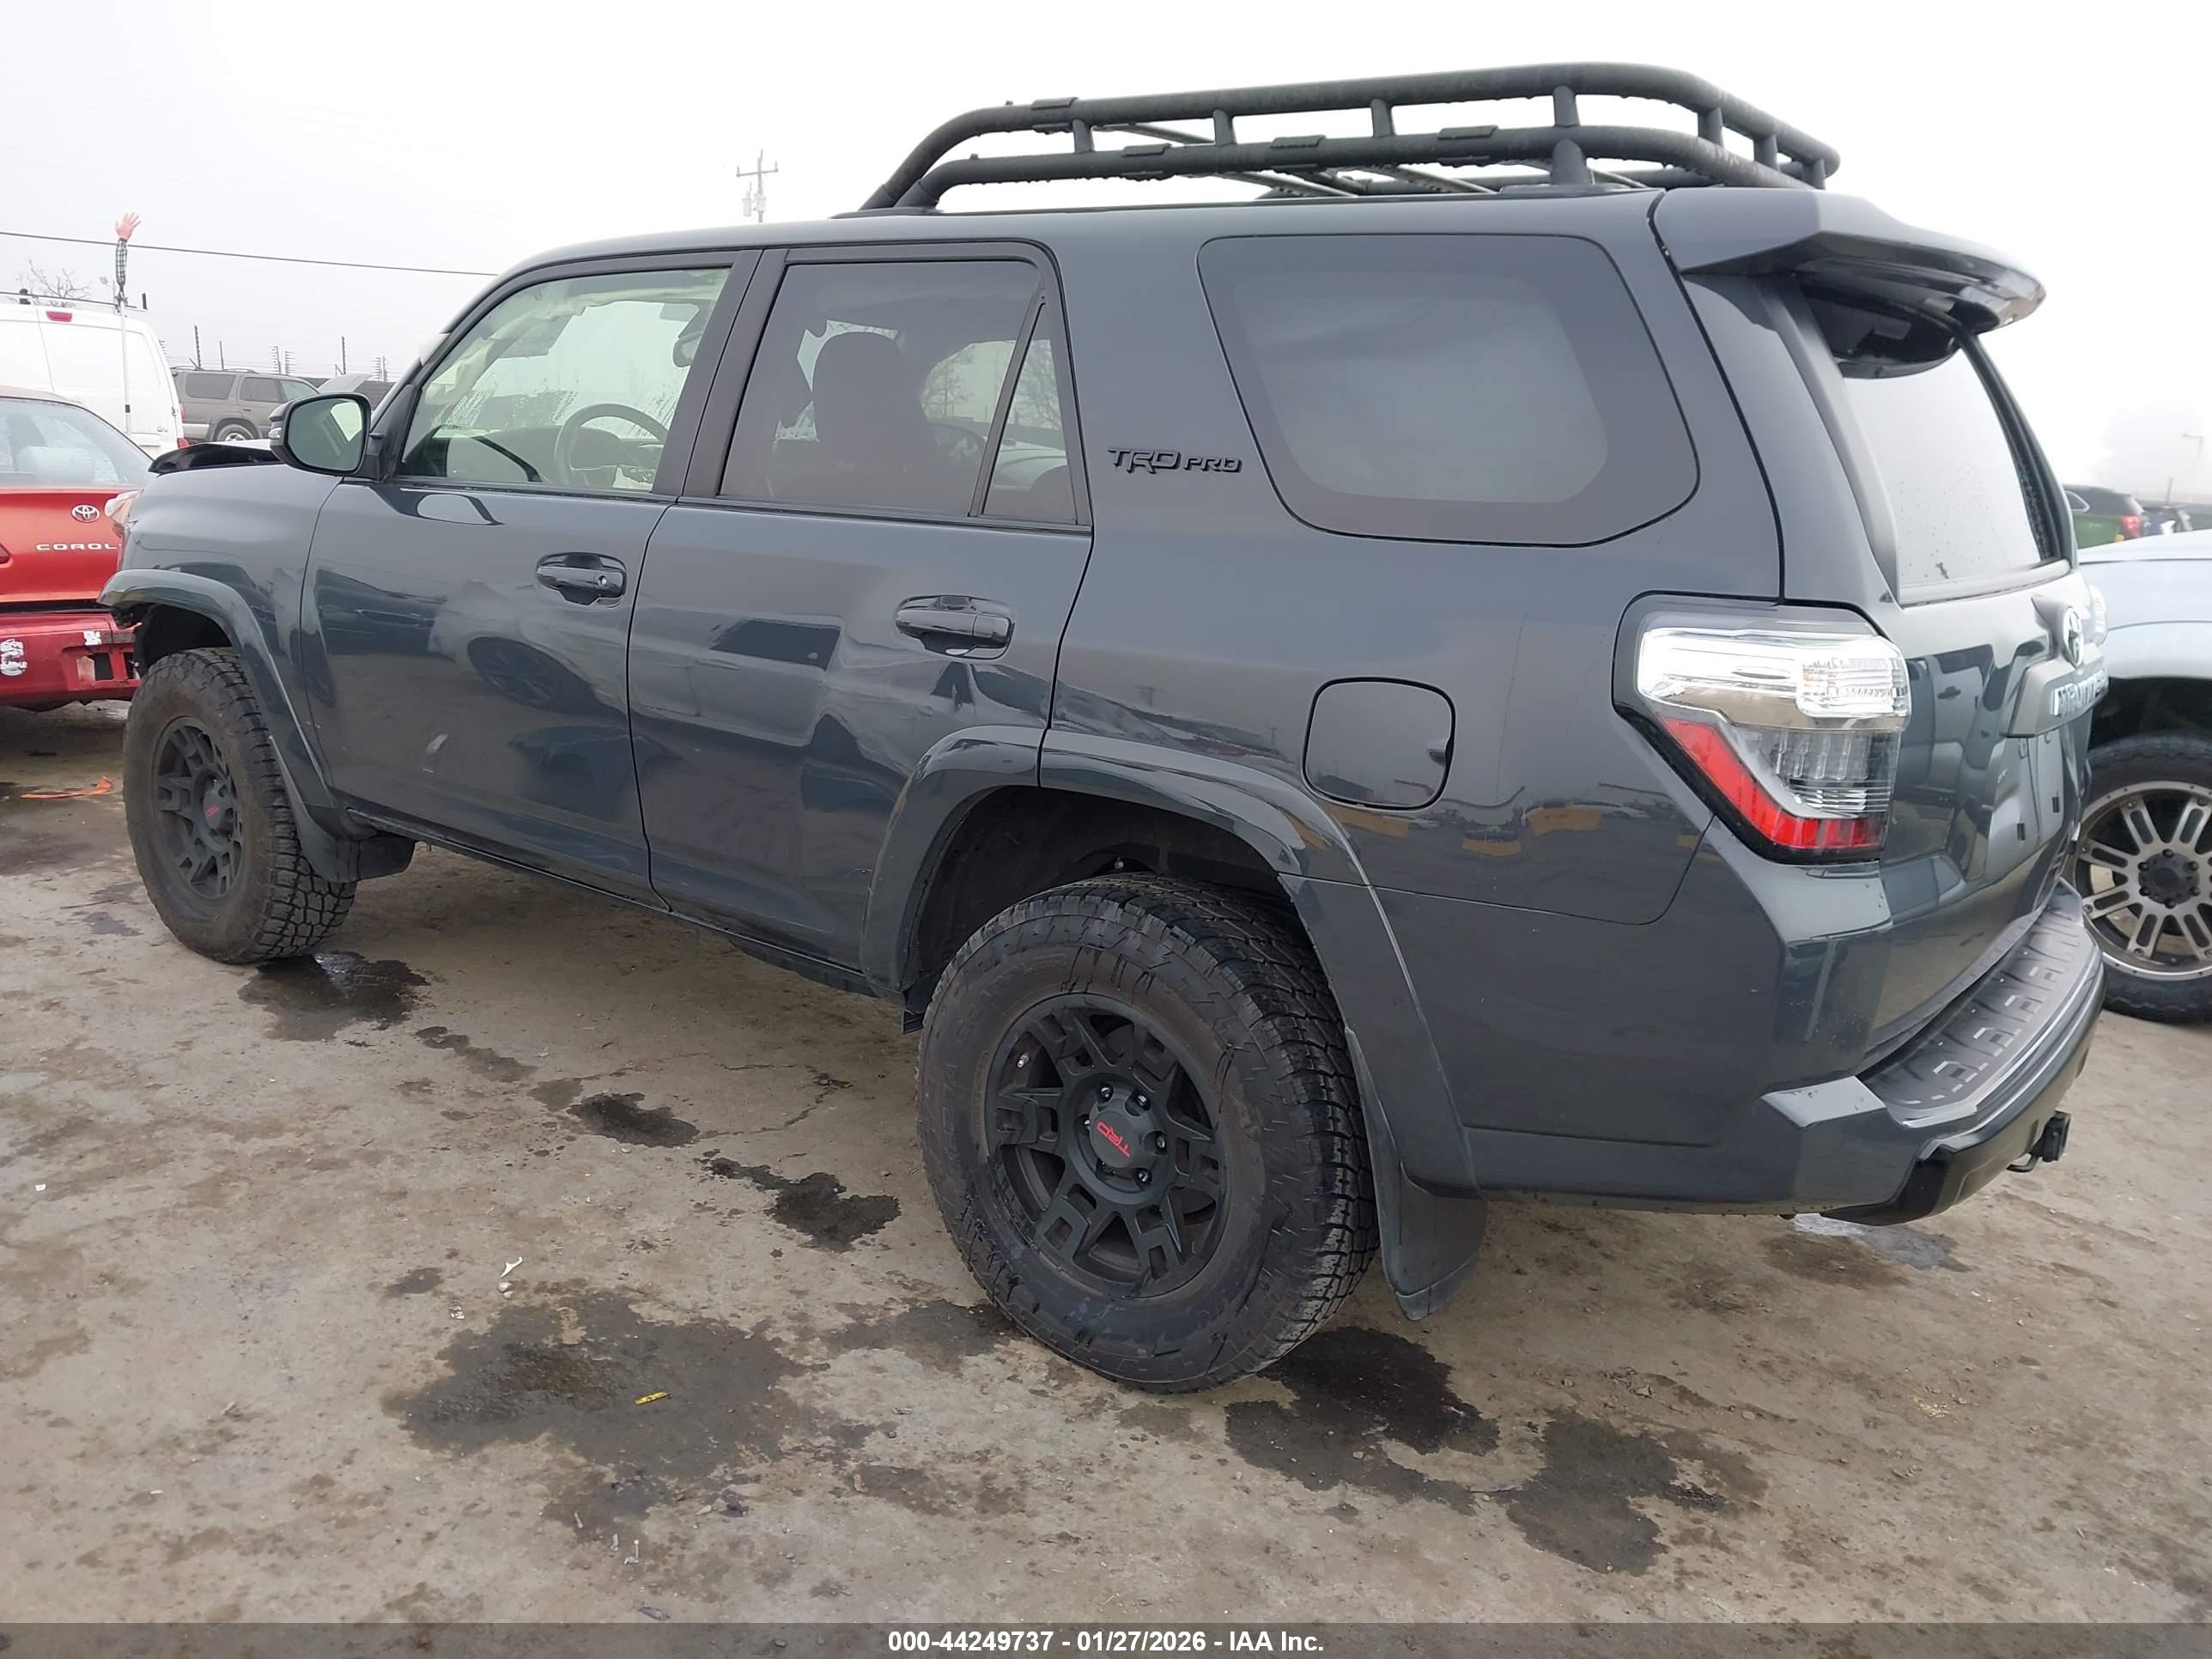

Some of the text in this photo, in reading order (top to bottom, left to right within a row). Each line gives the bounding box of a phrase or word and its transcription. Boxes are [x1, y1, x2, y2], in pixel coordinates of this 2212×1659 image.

[1107, 448, 1243, 474] TRD PRO
[1096, 1121, 1131, 1158] TRD
